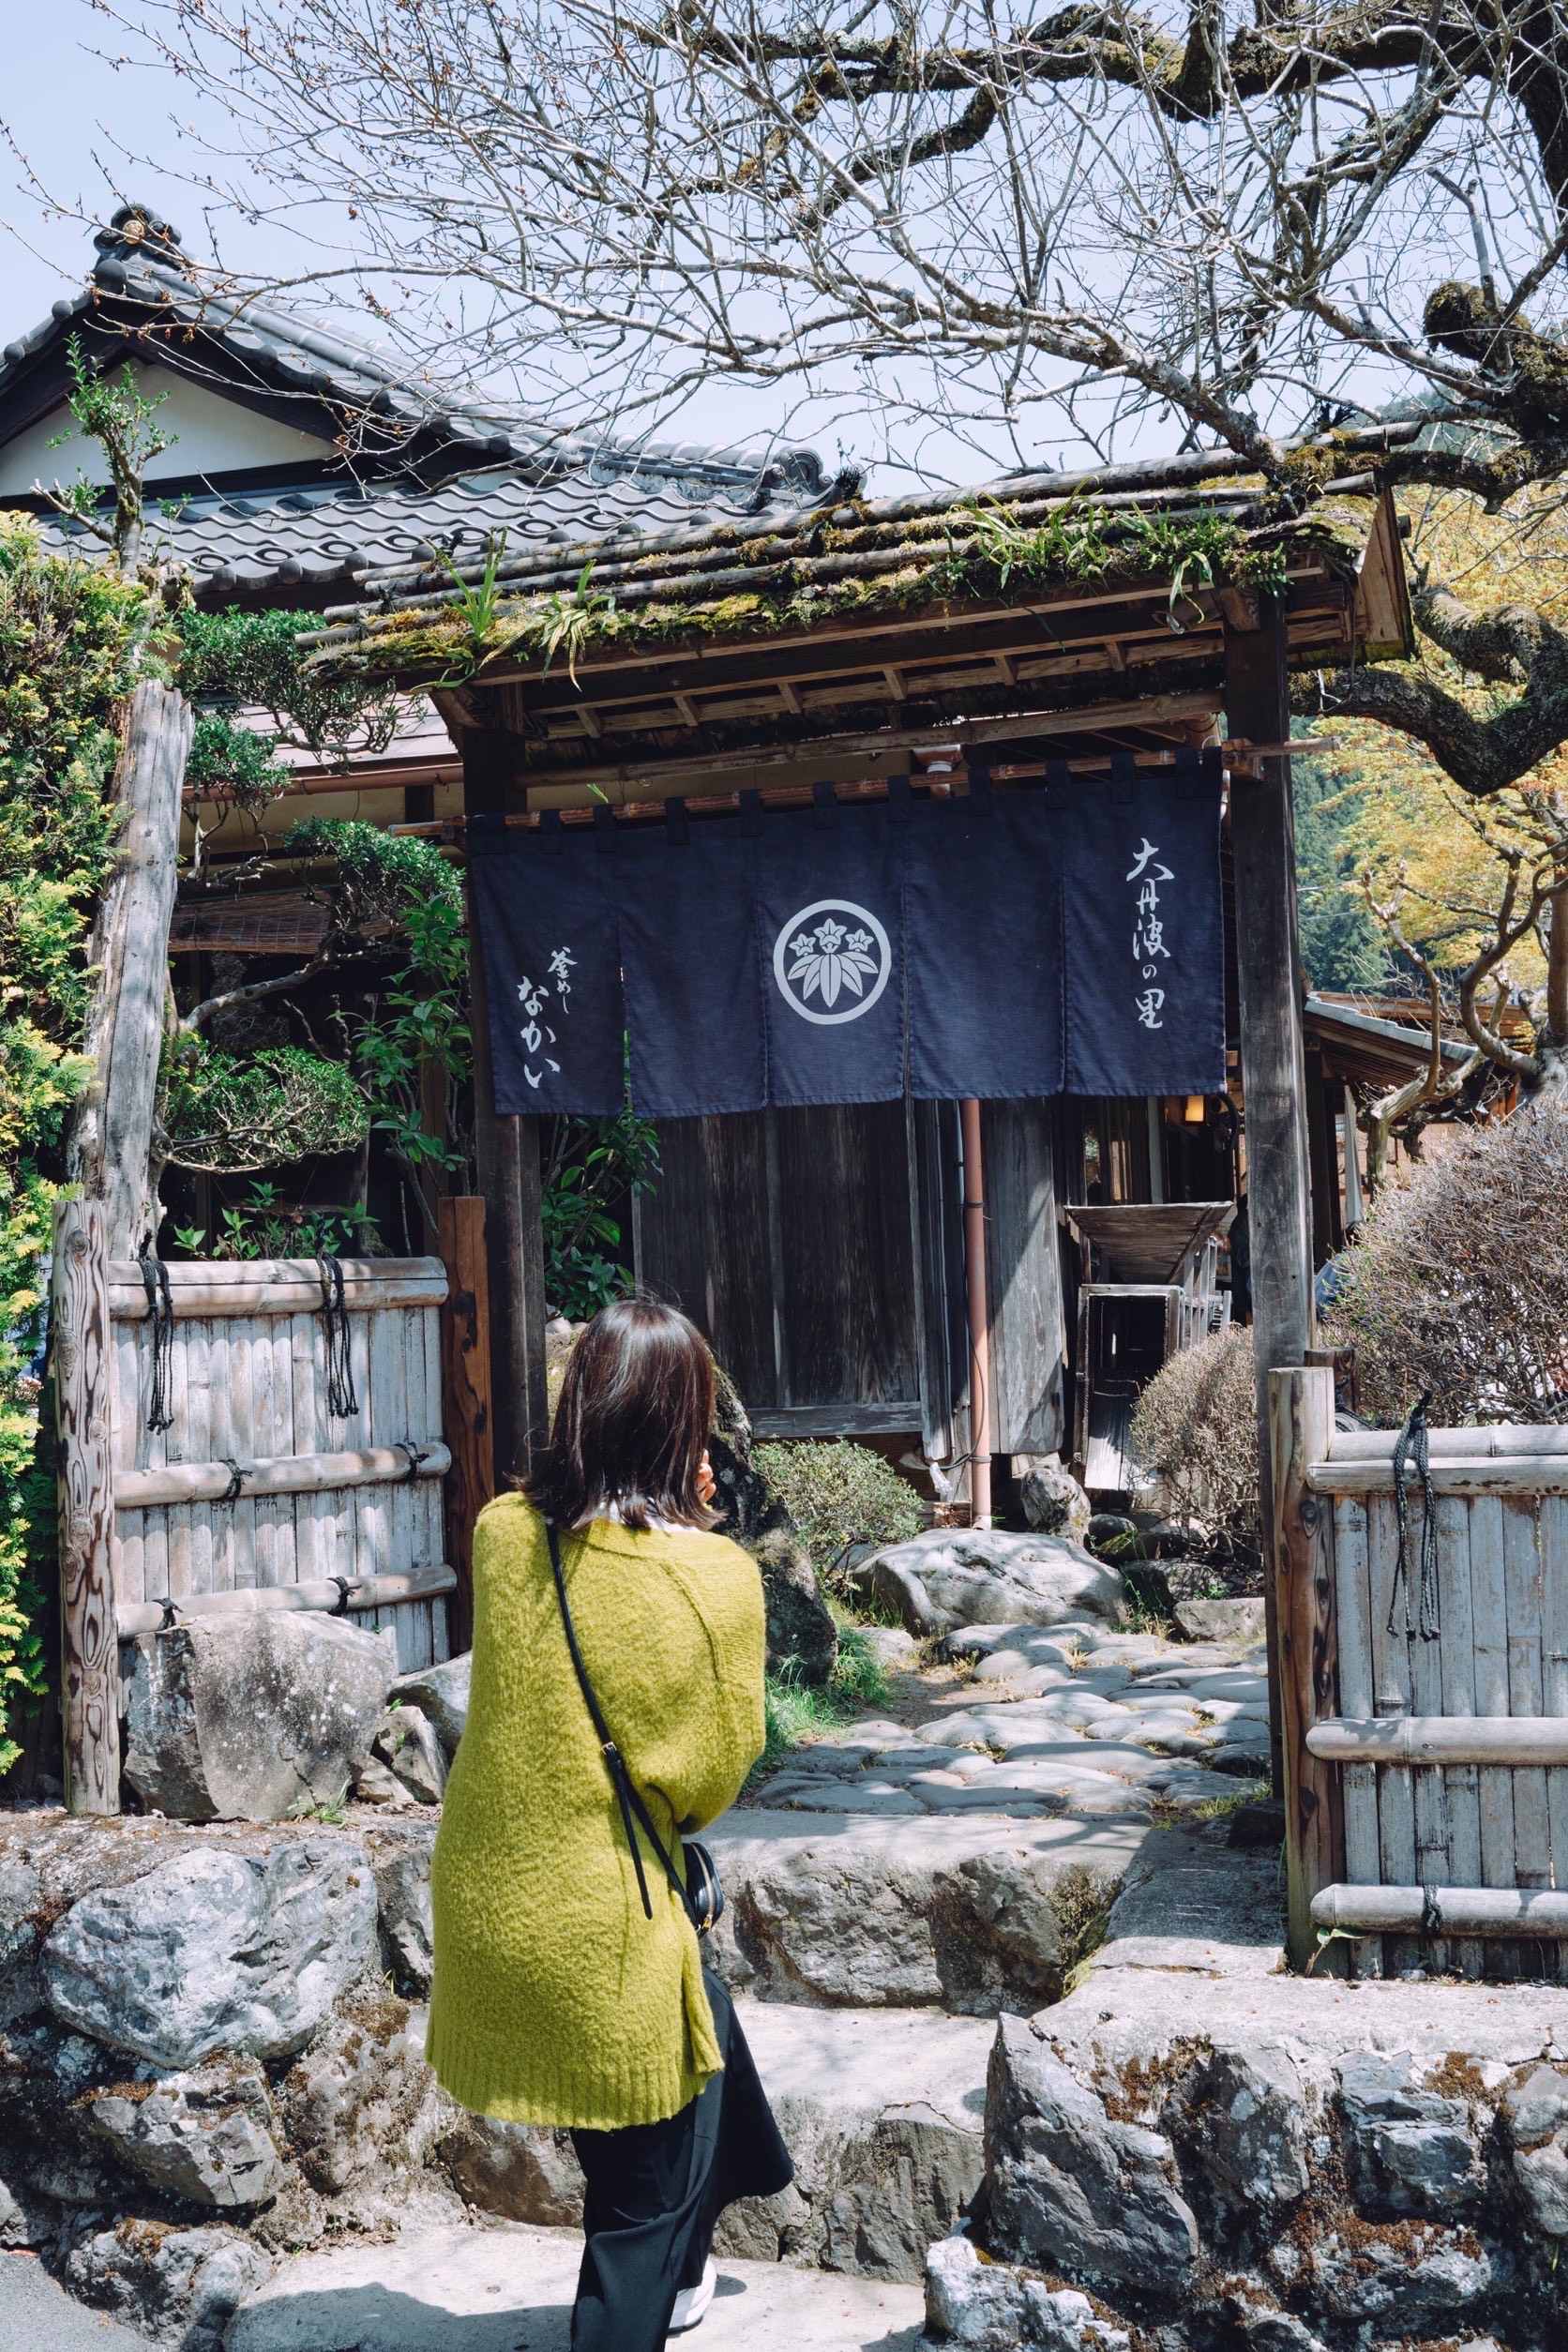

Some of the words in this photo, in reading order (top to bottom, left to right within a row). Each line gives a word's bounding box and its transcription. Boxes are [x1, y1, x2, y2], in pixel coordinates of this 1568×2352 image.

[547, 946, 578, 1015] 釜めし
[1126, 837, 1175, 1029] 大丹波の里
[517, 975, 561, 1089] なかい
